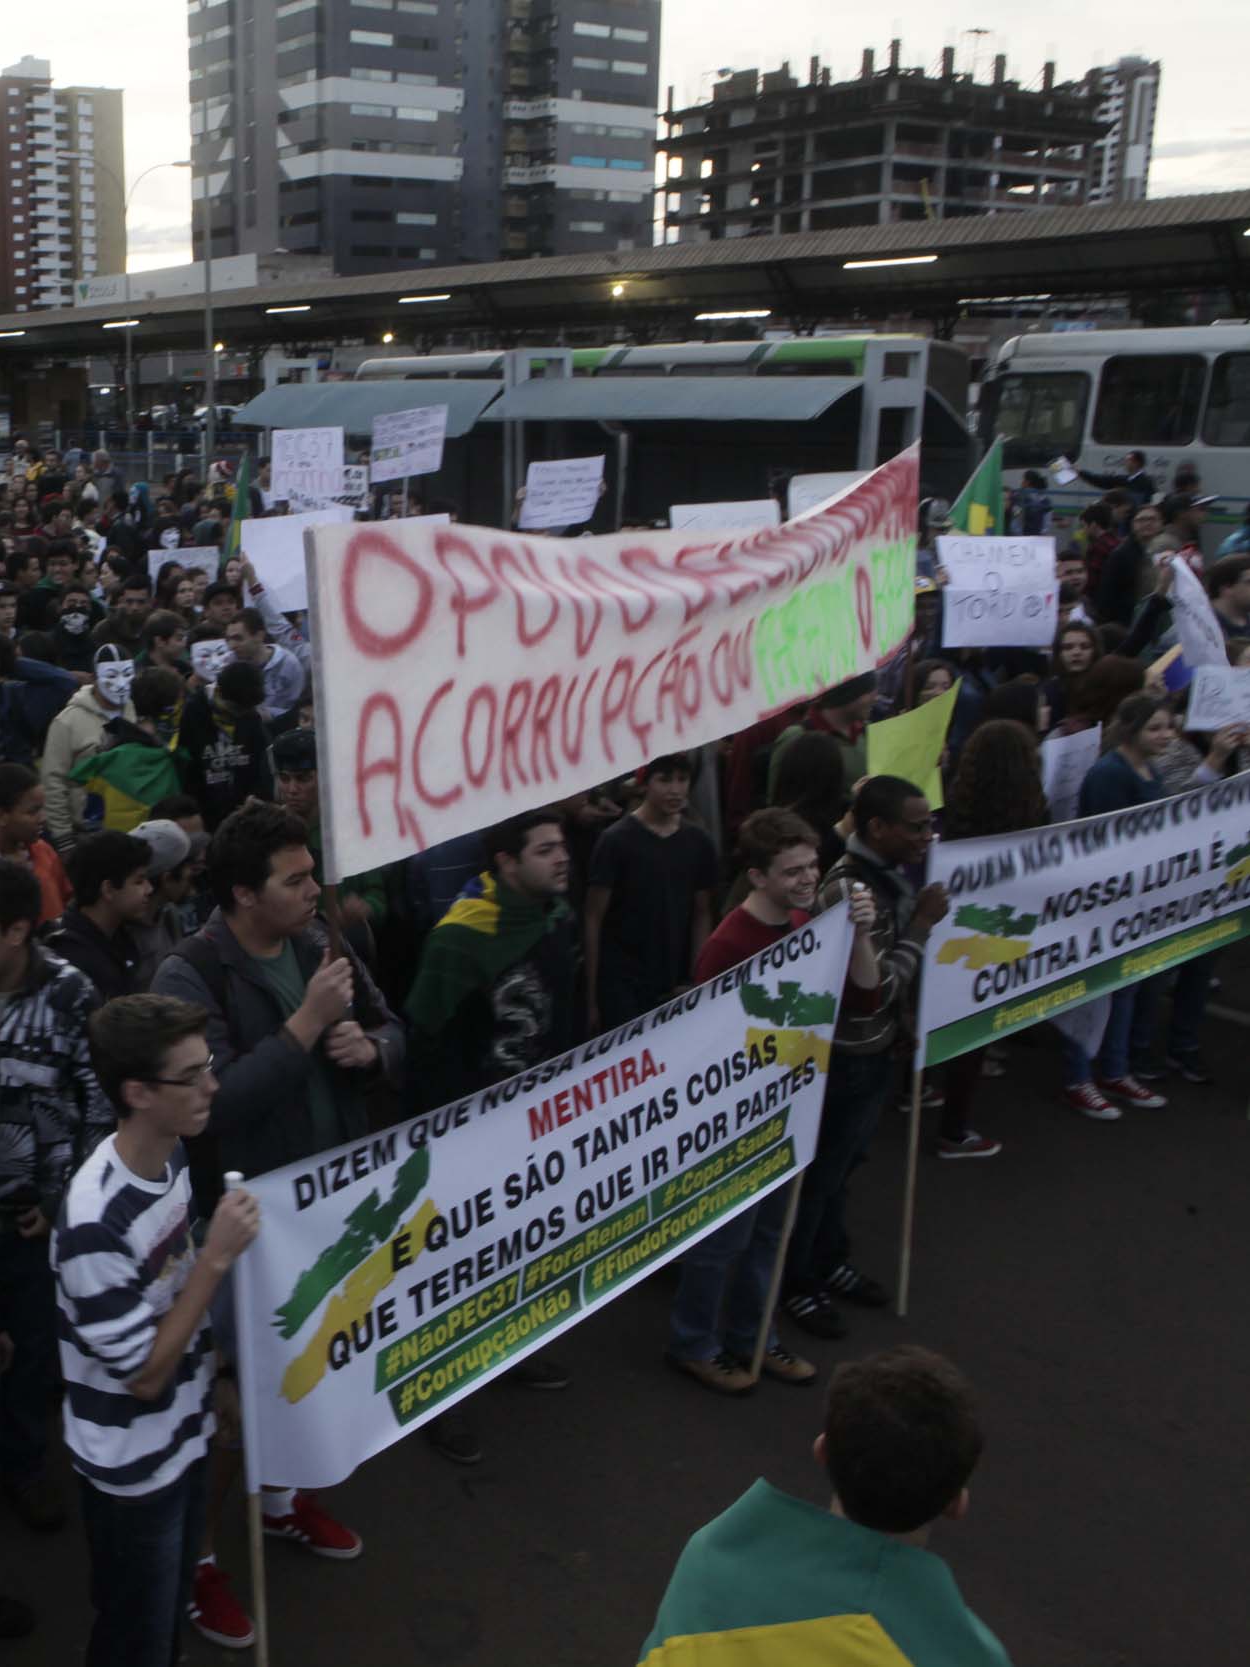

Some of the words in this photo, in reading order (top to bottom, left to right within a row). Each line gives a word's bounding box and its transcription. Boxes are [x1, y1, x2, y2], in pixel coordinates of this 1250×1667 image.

[341, 529, 435, 661] O
[410, 626, 703, 812] CORRUPÇÃO
[708, 615, 757, 708] OU
[947, 846, 1017, 896] QUEM
[1023, 835, 1064, 876] NÃO
[1066, 820, 1111, 858] TEM
[1042, 869, 1133, 926] NOSSA
[1140, 846, 1201, 895] LUTA
[1208, 830, 1224, 871] É
[971, 931, 1080, 1004] CONTRA
[1085, 924, 1104, 959] A
[292, 1130, 398, 1212] DIZEM
[406, 1097, 471, 1151] QUE
[478, 1053, 577, 1118] NOSSA
[581, 1014, 644, 1064] LUTA
[708, 961, 753, 1000] TEM
[757, 928, 822, 976] FOCO.
[424, 1187, 495, 1253] QUE
[504, 1149, 566, 1209] SÃO
[572, 1086, 679, 1170] TANTAS
[685, 1033, 779, 1108] COISAS
[526, 1048, 667, 1143] MENTIRA.
[325, 1297, 399, 1372] QUE
[407, 1206, 567, 1319] TEREMOS
[574, 1163, 635, 1224] QUE
[642, 1146, 669, 1189] IR
[676, 1112, 728, 1168] POR
[734, 1056, 816, 1131] PARTES
[384, 1276, 519, 1380] #NãoPEC37
[523, 1202, 649, 1294] #ForaRenan
[398, 1285, 572, 1414] #CorrupçãoNão
[591, 1144, 792, 1291] #FimdoForoPrivilegiado
